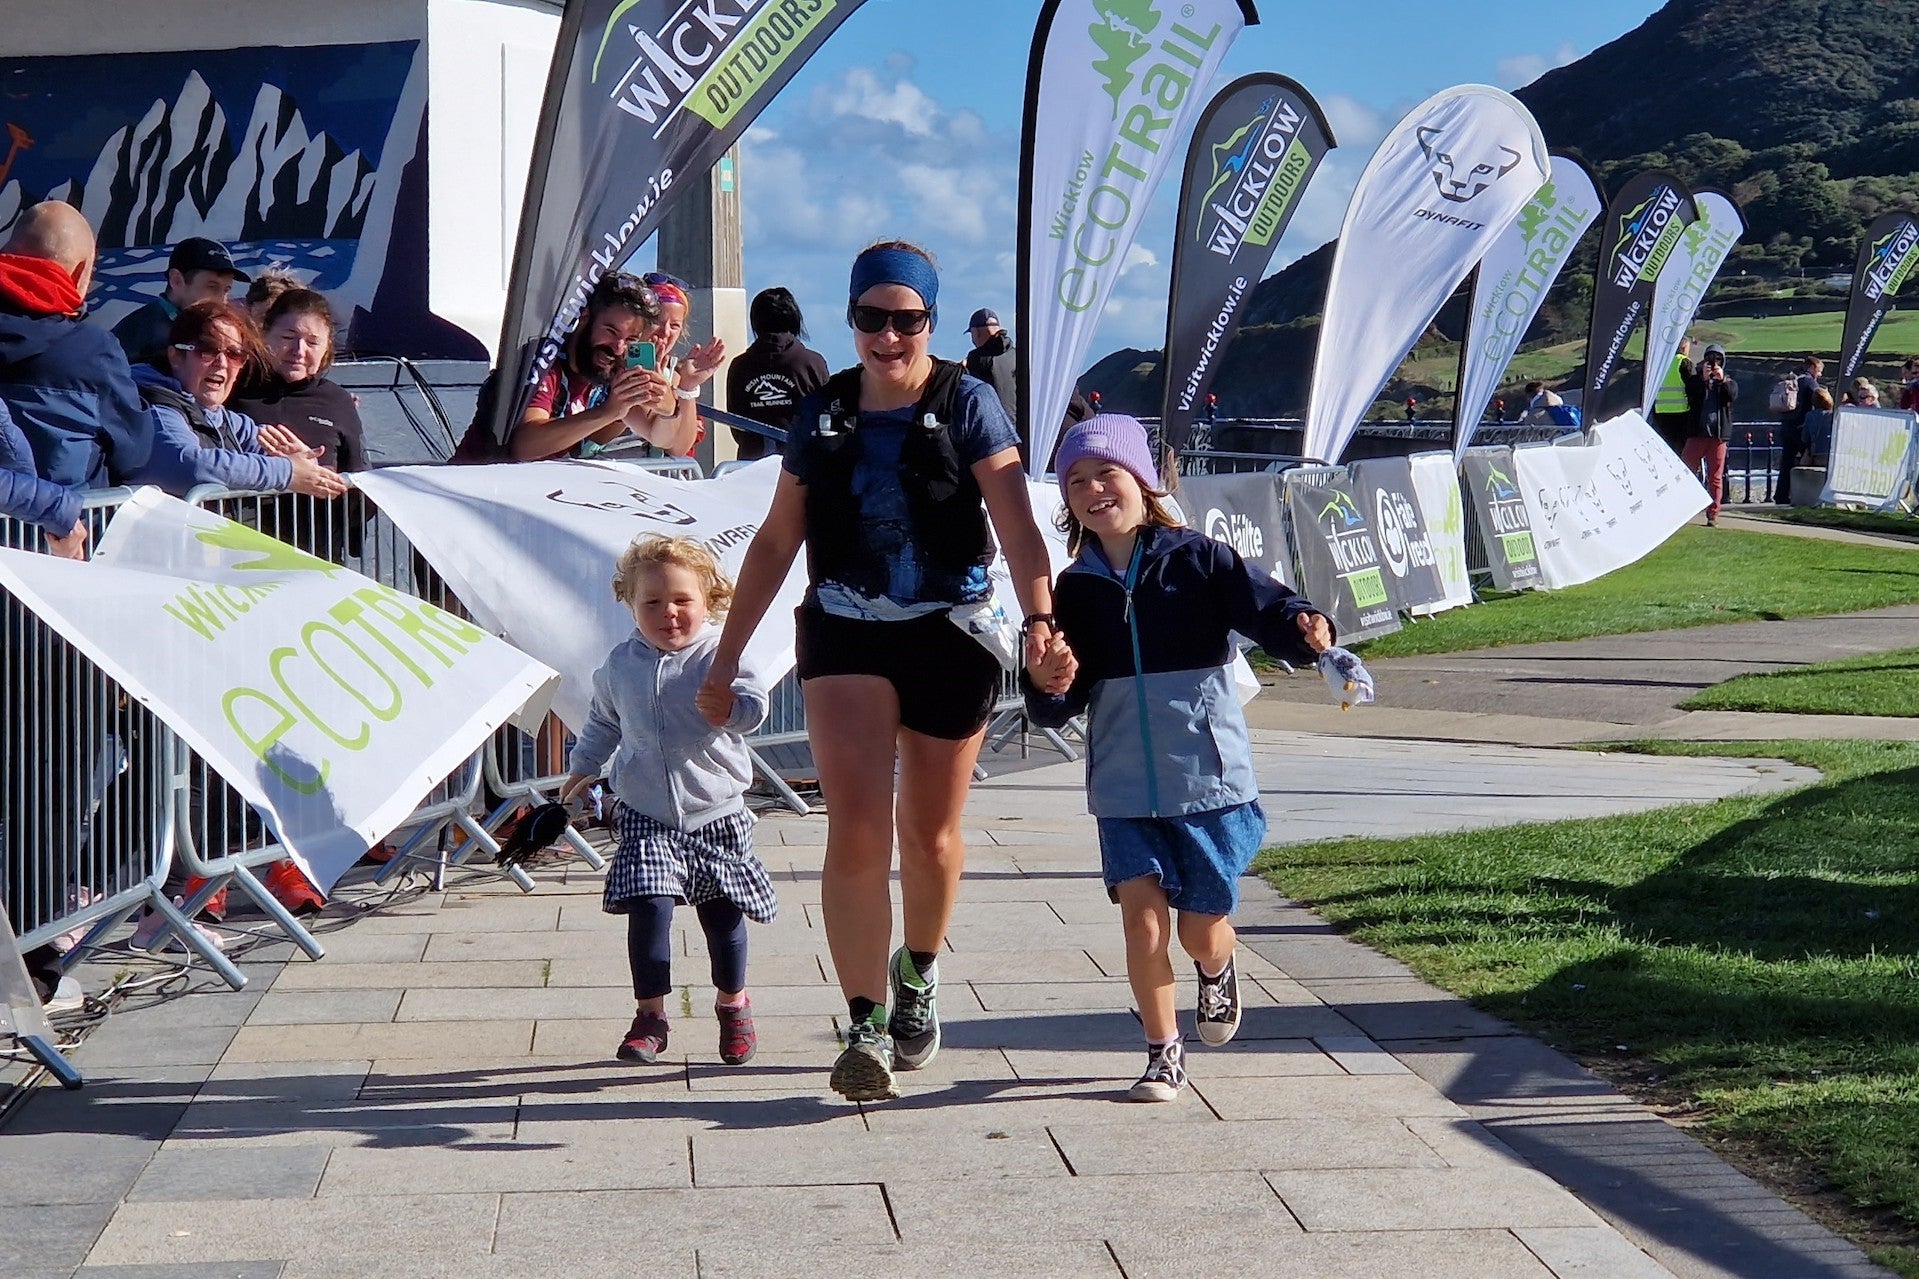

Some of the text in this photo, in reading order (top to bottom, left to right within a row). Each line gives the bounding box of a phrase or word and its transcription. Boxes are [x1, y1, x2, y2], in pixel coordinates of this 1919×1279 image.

[706, 0, 822, 114] OUTDOORS
[1048, 150, 1095, 241] Wicklow
[1209, 101, 1301, 258] WICKLOW
[1253, 152, 1305, 238] OUTDOORS
[1412, 208, 1486, 232] DYNAFIT
[1616, 188, 1680, 290] WICKLOW
[1645, 222, 1681, 277] OUTDOORS
[1866, 223, 1919, 302] WICKLOW
[1888, 250, 1919, 293] OUTDOORS
[1482, 268, 1513, 319] Wicklow
[760, 373, 796, 388] MOUNTAIN
[1178, 275, 1248, 412] visitwicklow.ie
[1593, 300, 1641, 391] visitwicklow.ie
[1230, 514, 1264, 559] Fáilte
